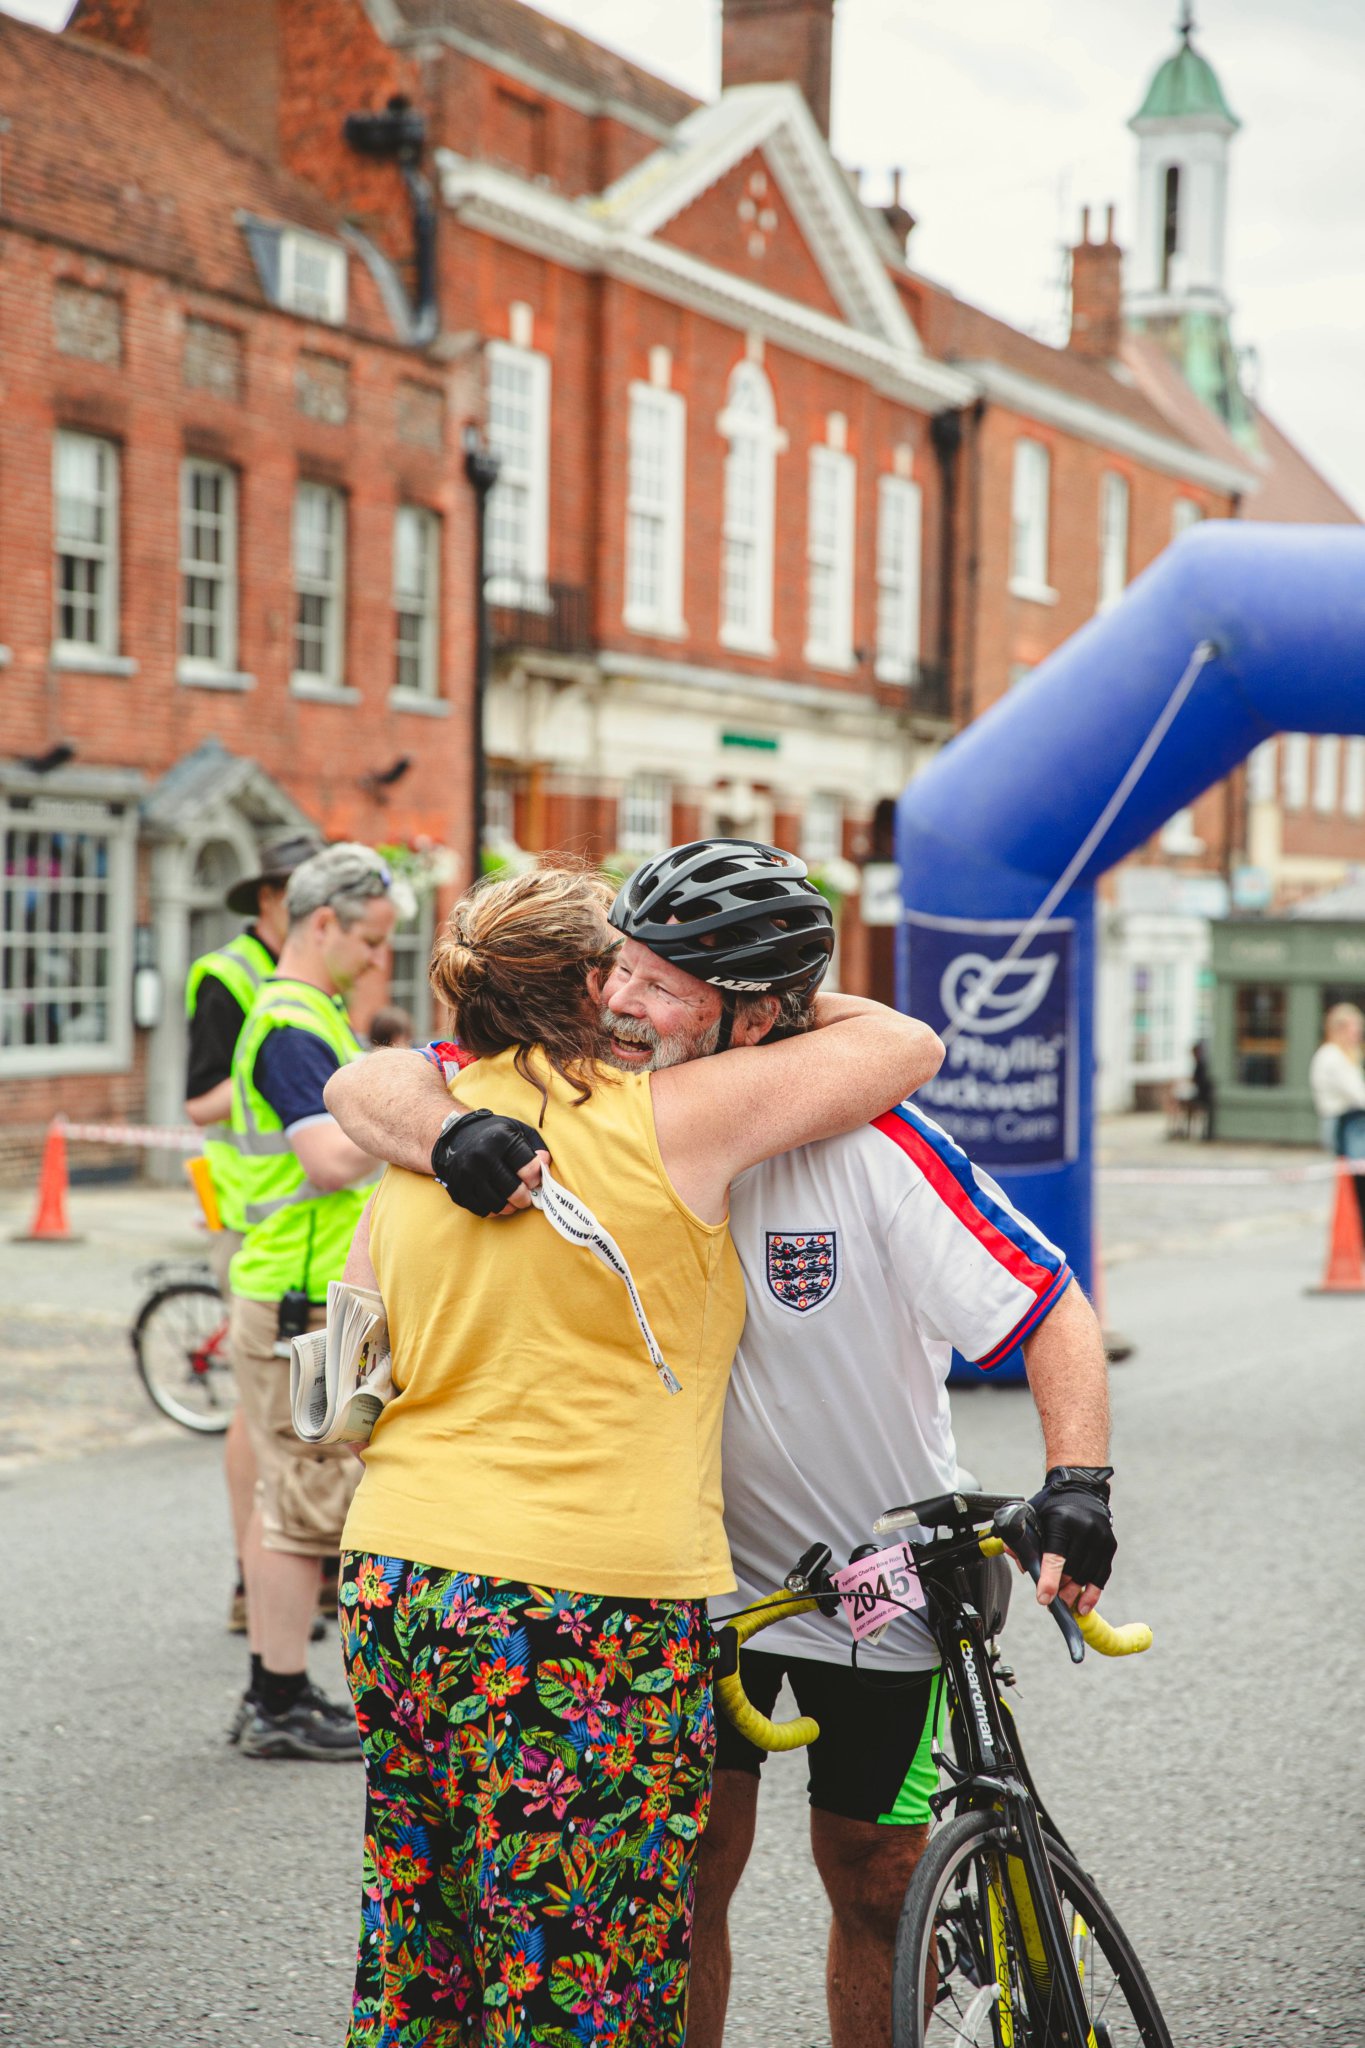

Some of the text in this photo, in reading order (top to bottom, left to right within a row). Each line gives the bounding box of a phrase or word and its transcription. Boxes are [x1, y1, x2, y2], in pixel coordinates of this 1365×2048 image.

[705, 976, 772, 992] LAZER
[918, 1072, 1059, 1111] uckwell
[557, 1214, 593, 1240] ARNHAM
[592, 1234, 625, 1274] FARNHAM
[858, 1565, 876, 1577] Charity
[848, 1567, 910, 1621] 2045
